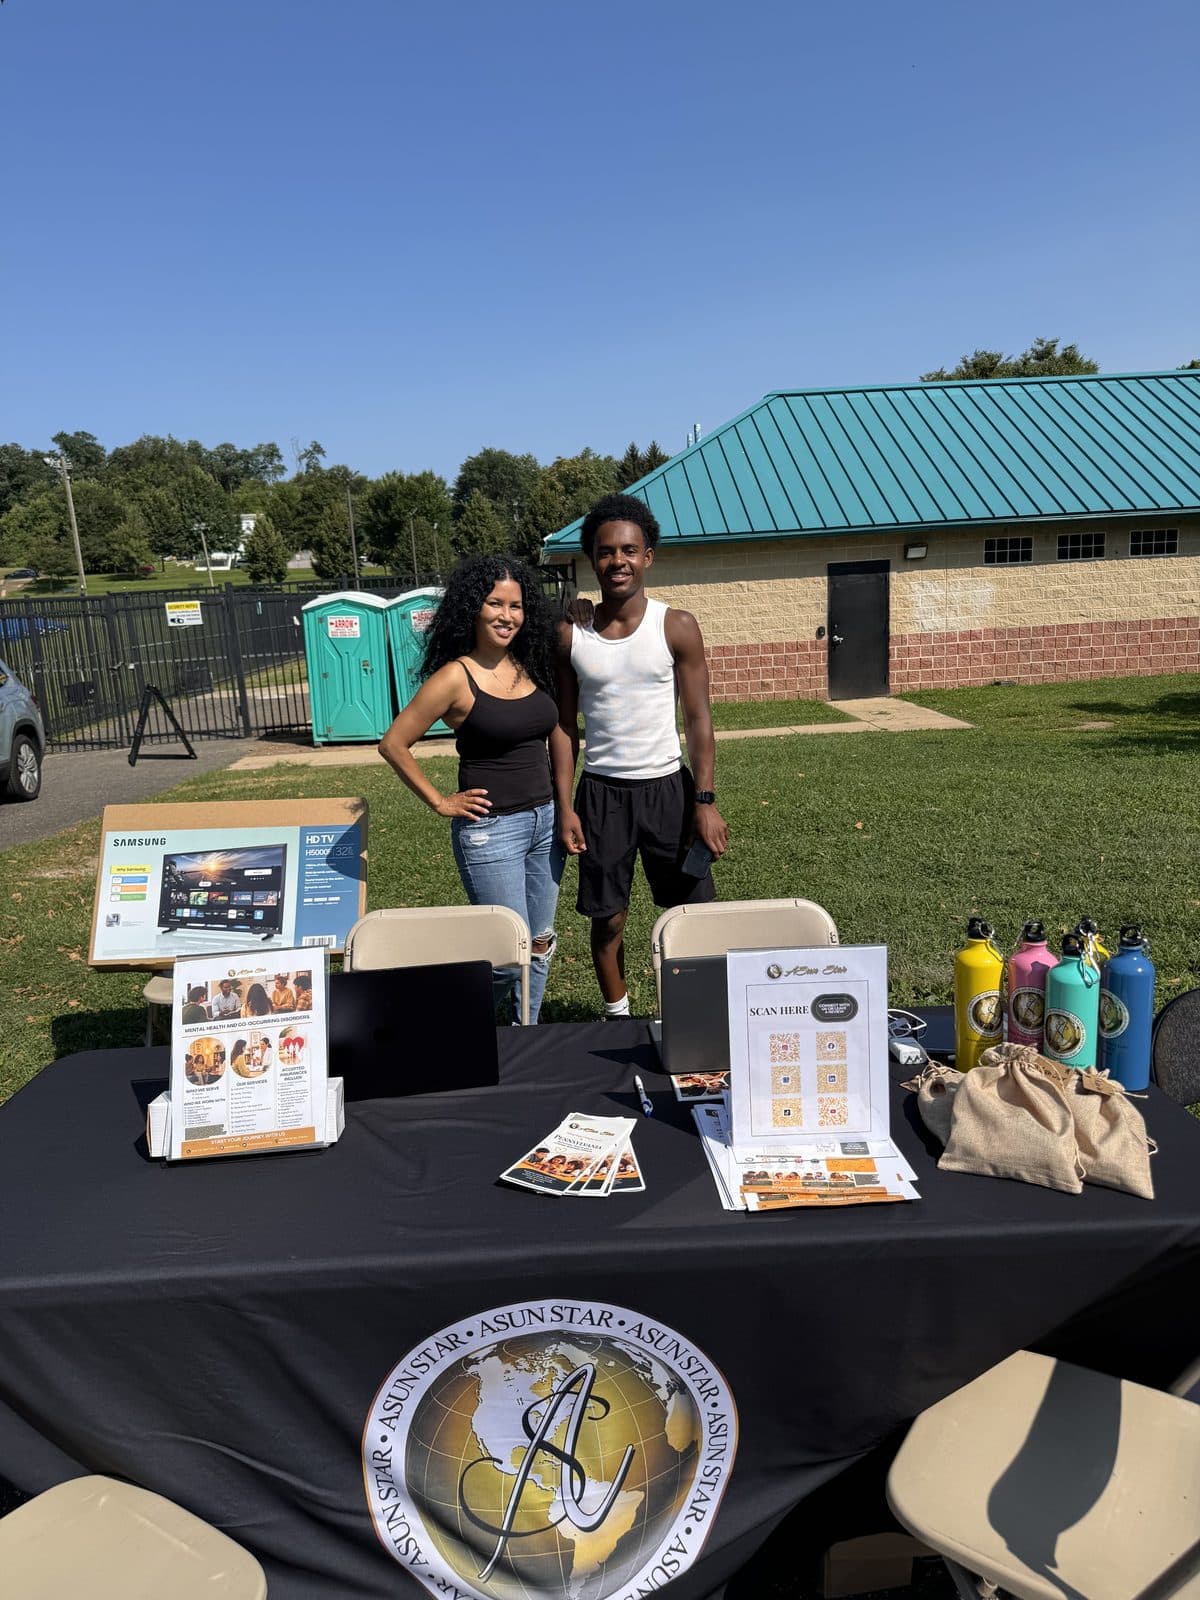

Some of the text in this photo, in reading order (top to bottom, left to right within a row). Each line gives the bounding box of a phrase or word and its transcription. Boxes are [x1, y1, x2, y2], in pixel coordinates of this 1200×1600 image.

[334, 619, 354, 629] ARROW
[113, 837, 167, 847] SAMSUNG
[305, 834, 335, 844] HD TV
[280, 1014, 310, 1023] DISORDERS
[749, 1005, 809, 1017] SCAN HERE
[480, 1305, 614, 1338] ASUN STAR
[624, 1322, 720, 1404] ASUN STAR
[378, 1333, 469, 1432] ASUN STAR
[684, 1411, 729, 1523] ASUN STAR
[372, 1445, 430, 1566] ASUN STAR
